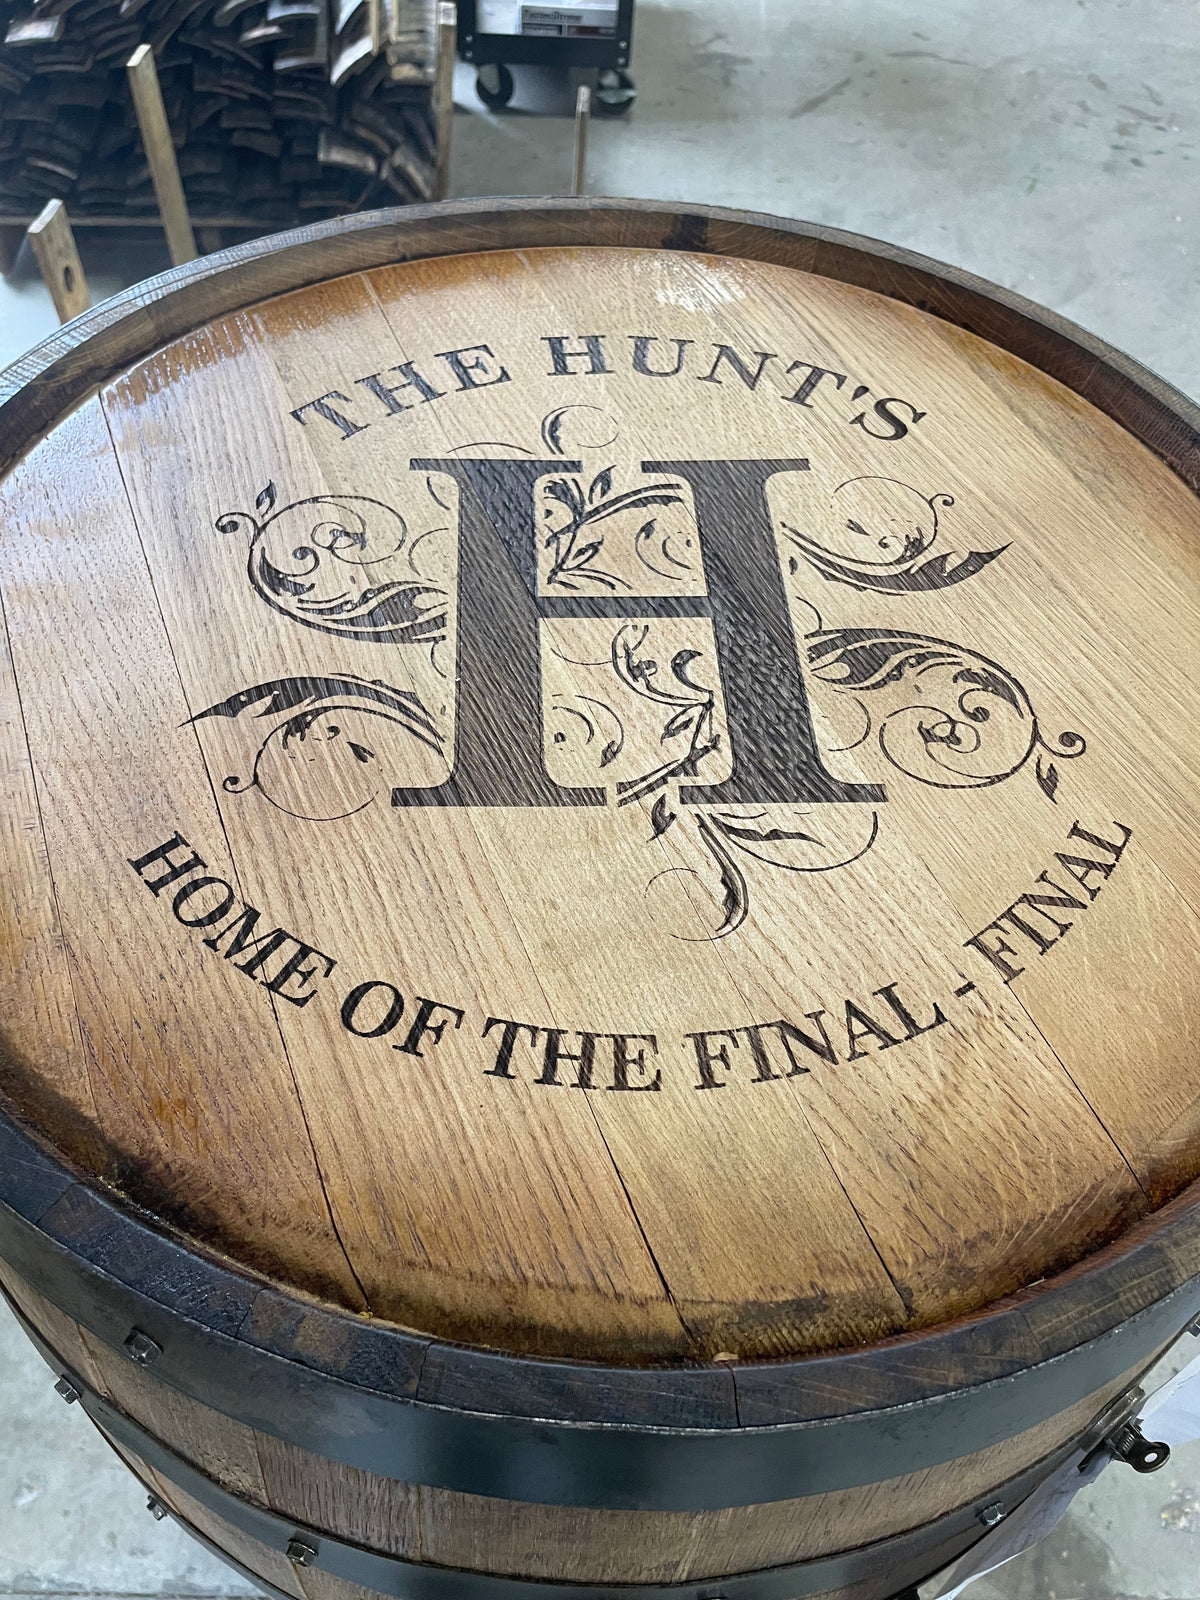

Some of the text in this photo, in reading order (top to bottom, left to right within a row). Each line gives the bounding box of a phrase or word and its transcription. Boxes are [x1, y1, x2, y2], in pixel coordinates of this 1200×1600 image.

[290, 335, 926, 441] THE HUNT'S
[391, 458, 886, 806] H
[128, 831, 336, 1008] HOME
[341, 980, 464, 1058] OF
[481, 1017, 662, 1091] THE
